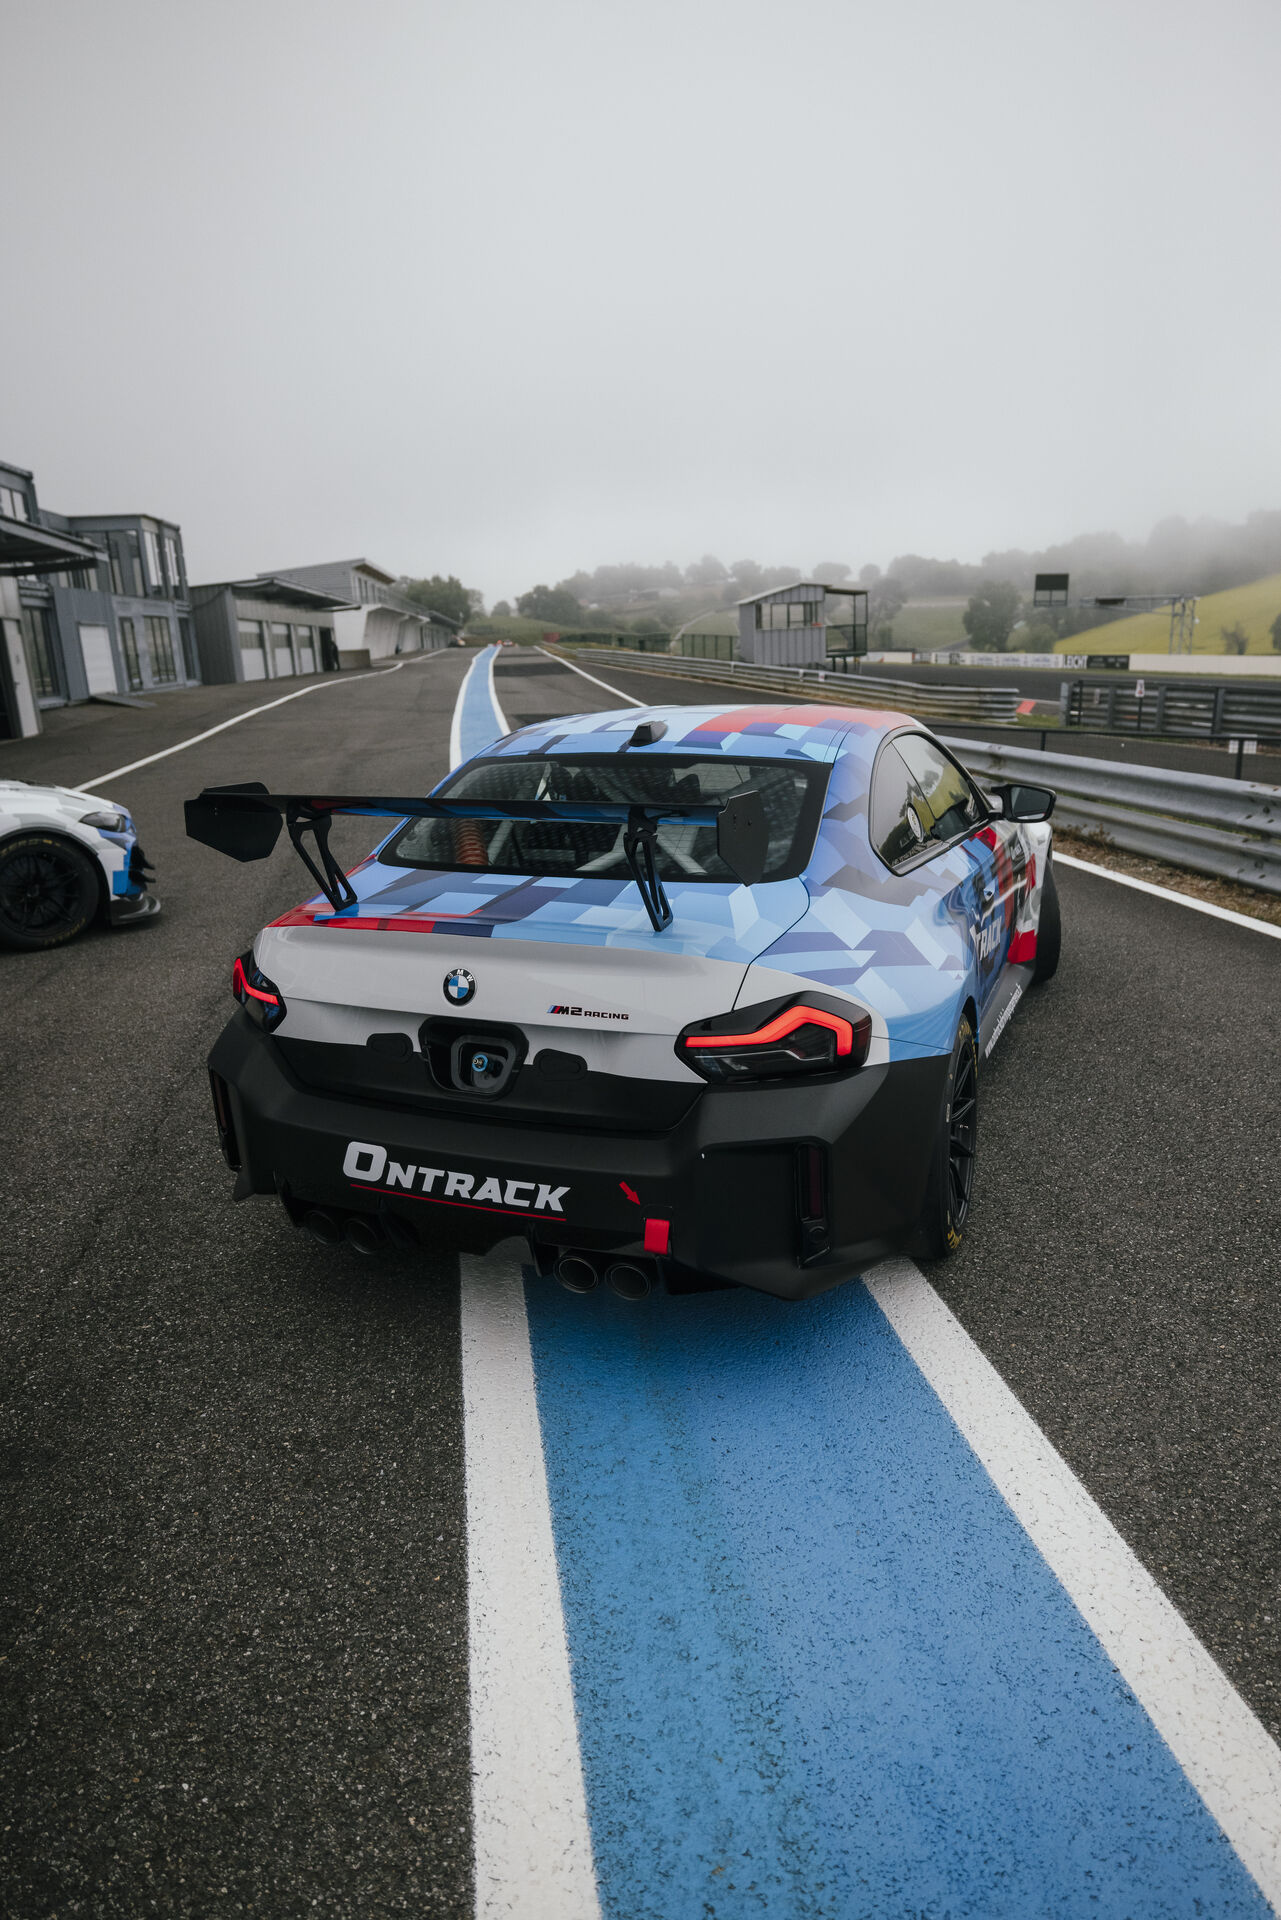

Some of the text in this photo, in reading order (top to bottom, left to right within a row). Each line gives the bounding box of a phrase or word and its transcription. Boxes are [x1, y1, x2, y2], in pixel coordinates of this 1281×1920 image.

[447, 968, 475, 982] BMW
[584, 1010, 630, 1020] RACING
[343, 1141, 571, 1212] ONTRACK
